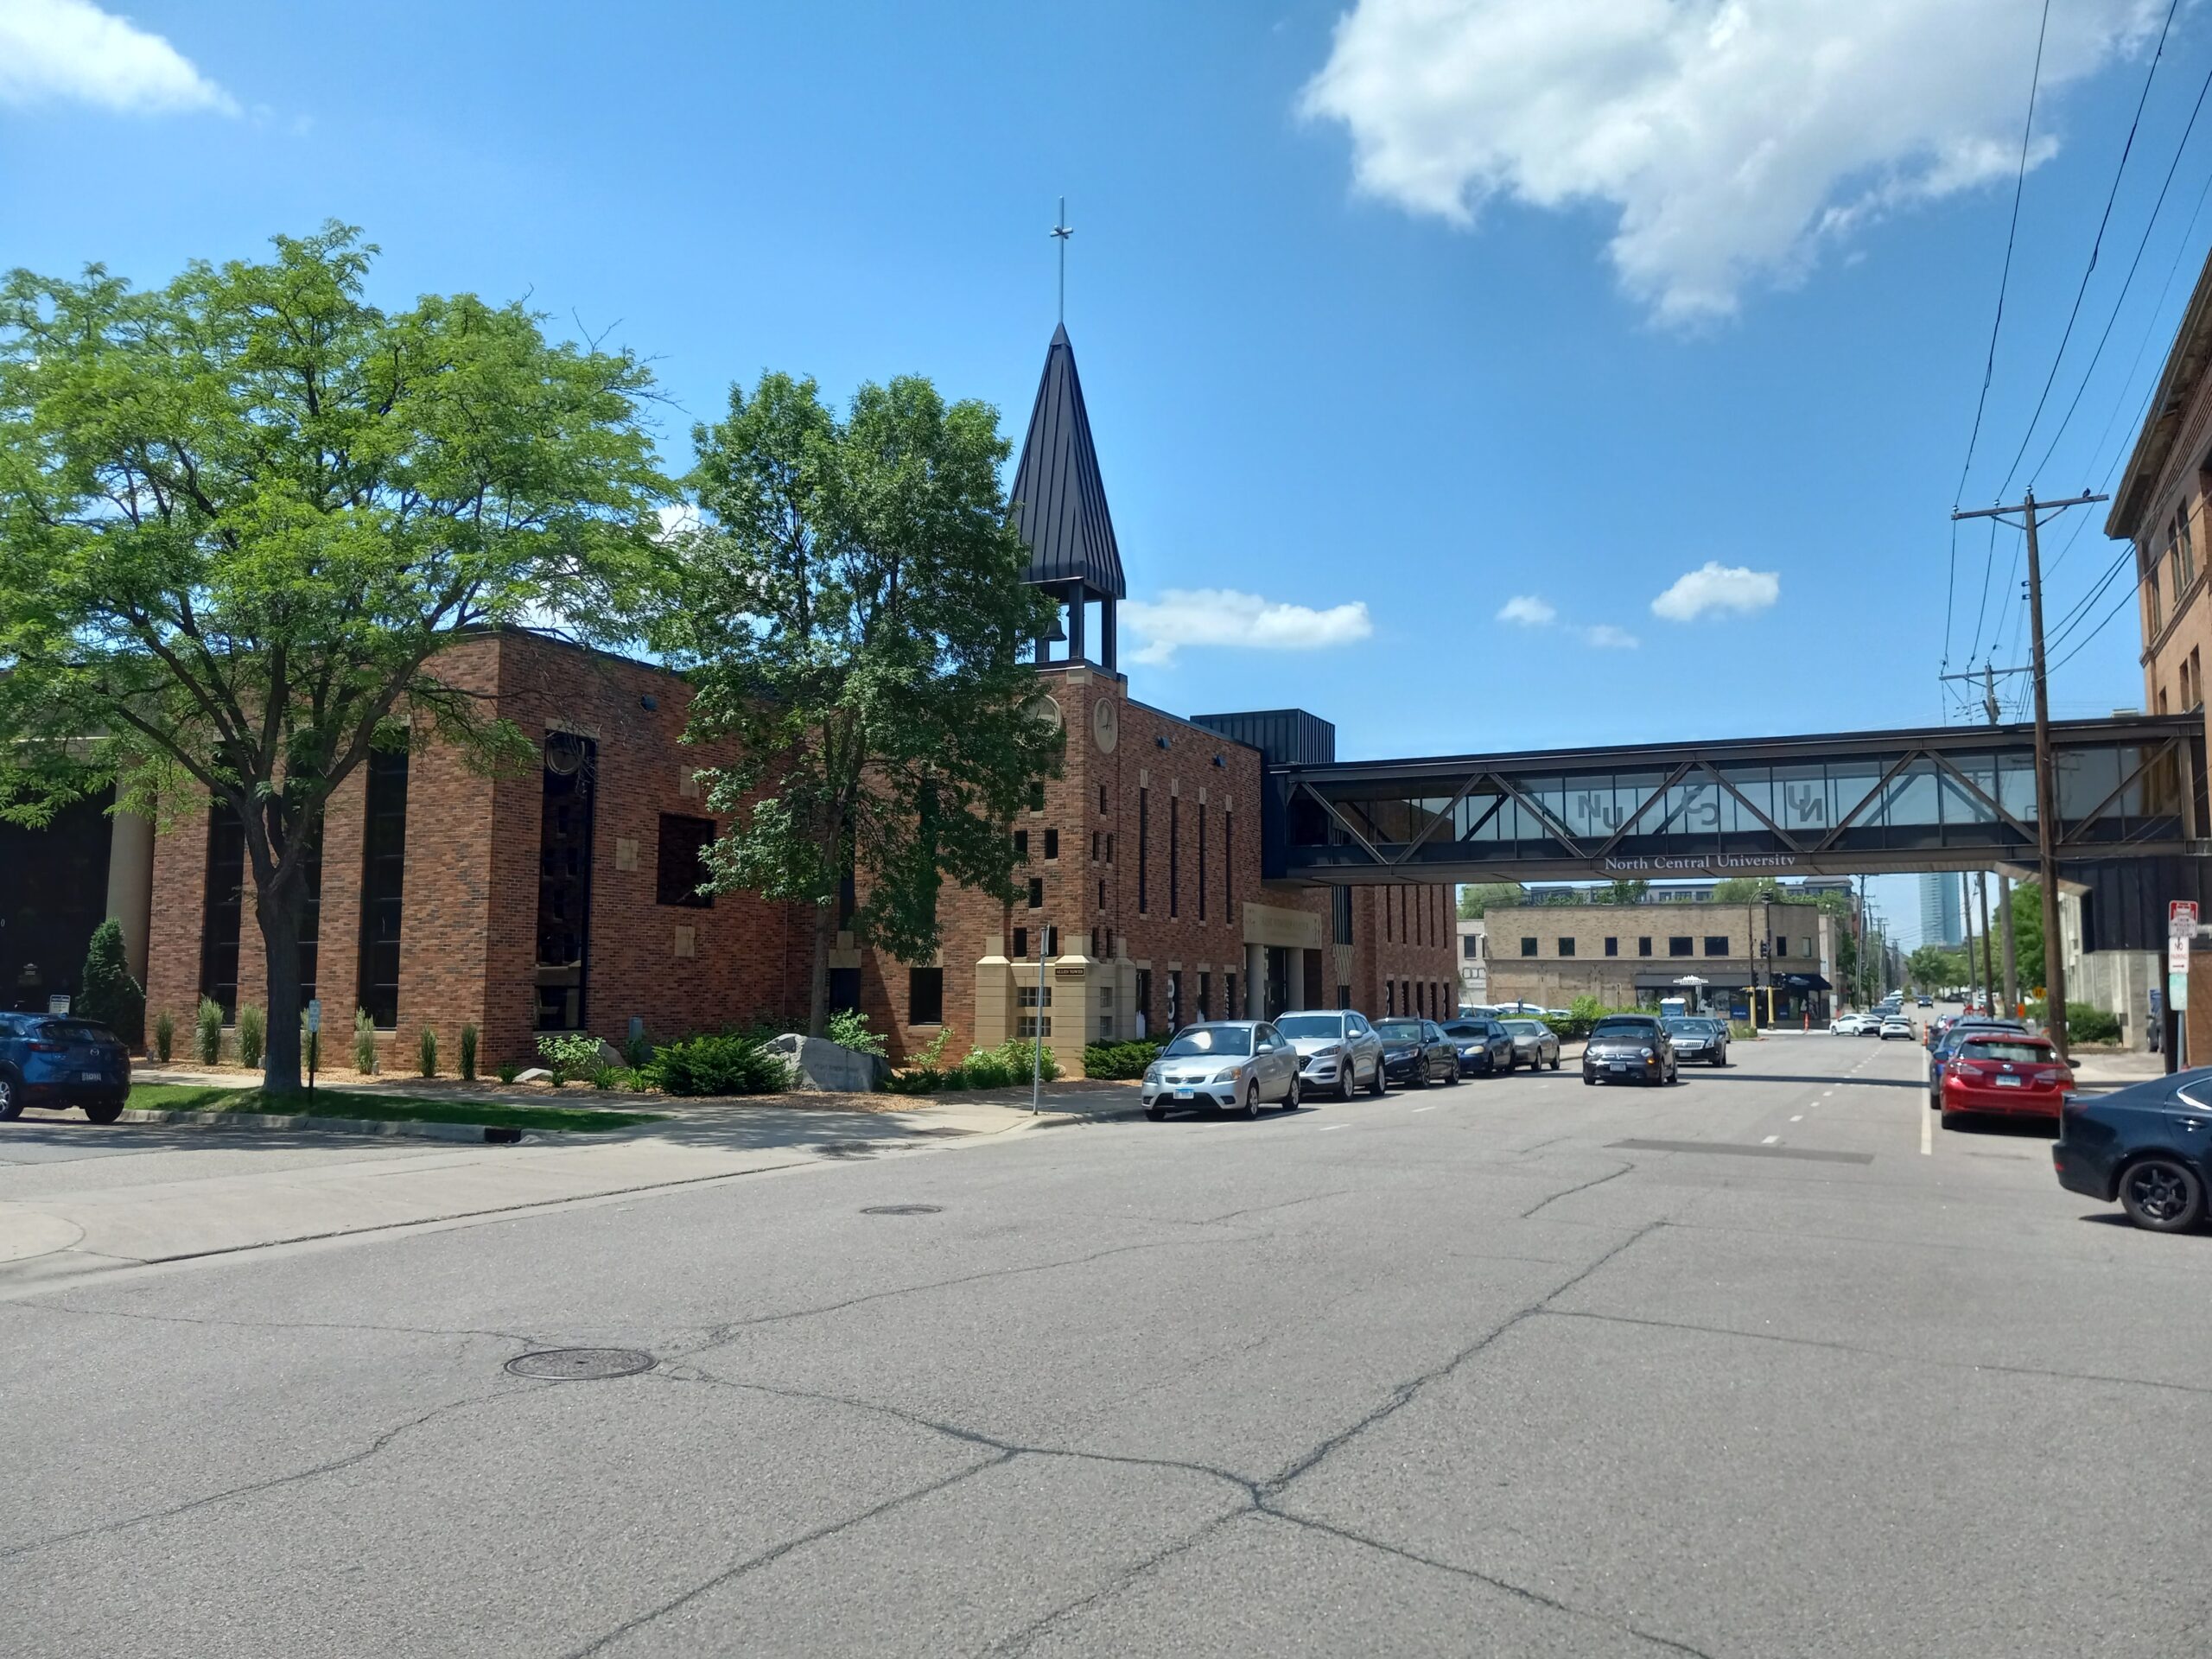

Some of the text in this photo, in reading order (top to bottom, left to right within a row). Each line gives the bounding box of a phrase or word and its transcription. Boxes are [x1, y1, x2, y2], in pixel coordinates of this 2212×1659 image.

[1605, 854, 1796, 870] North Central University
